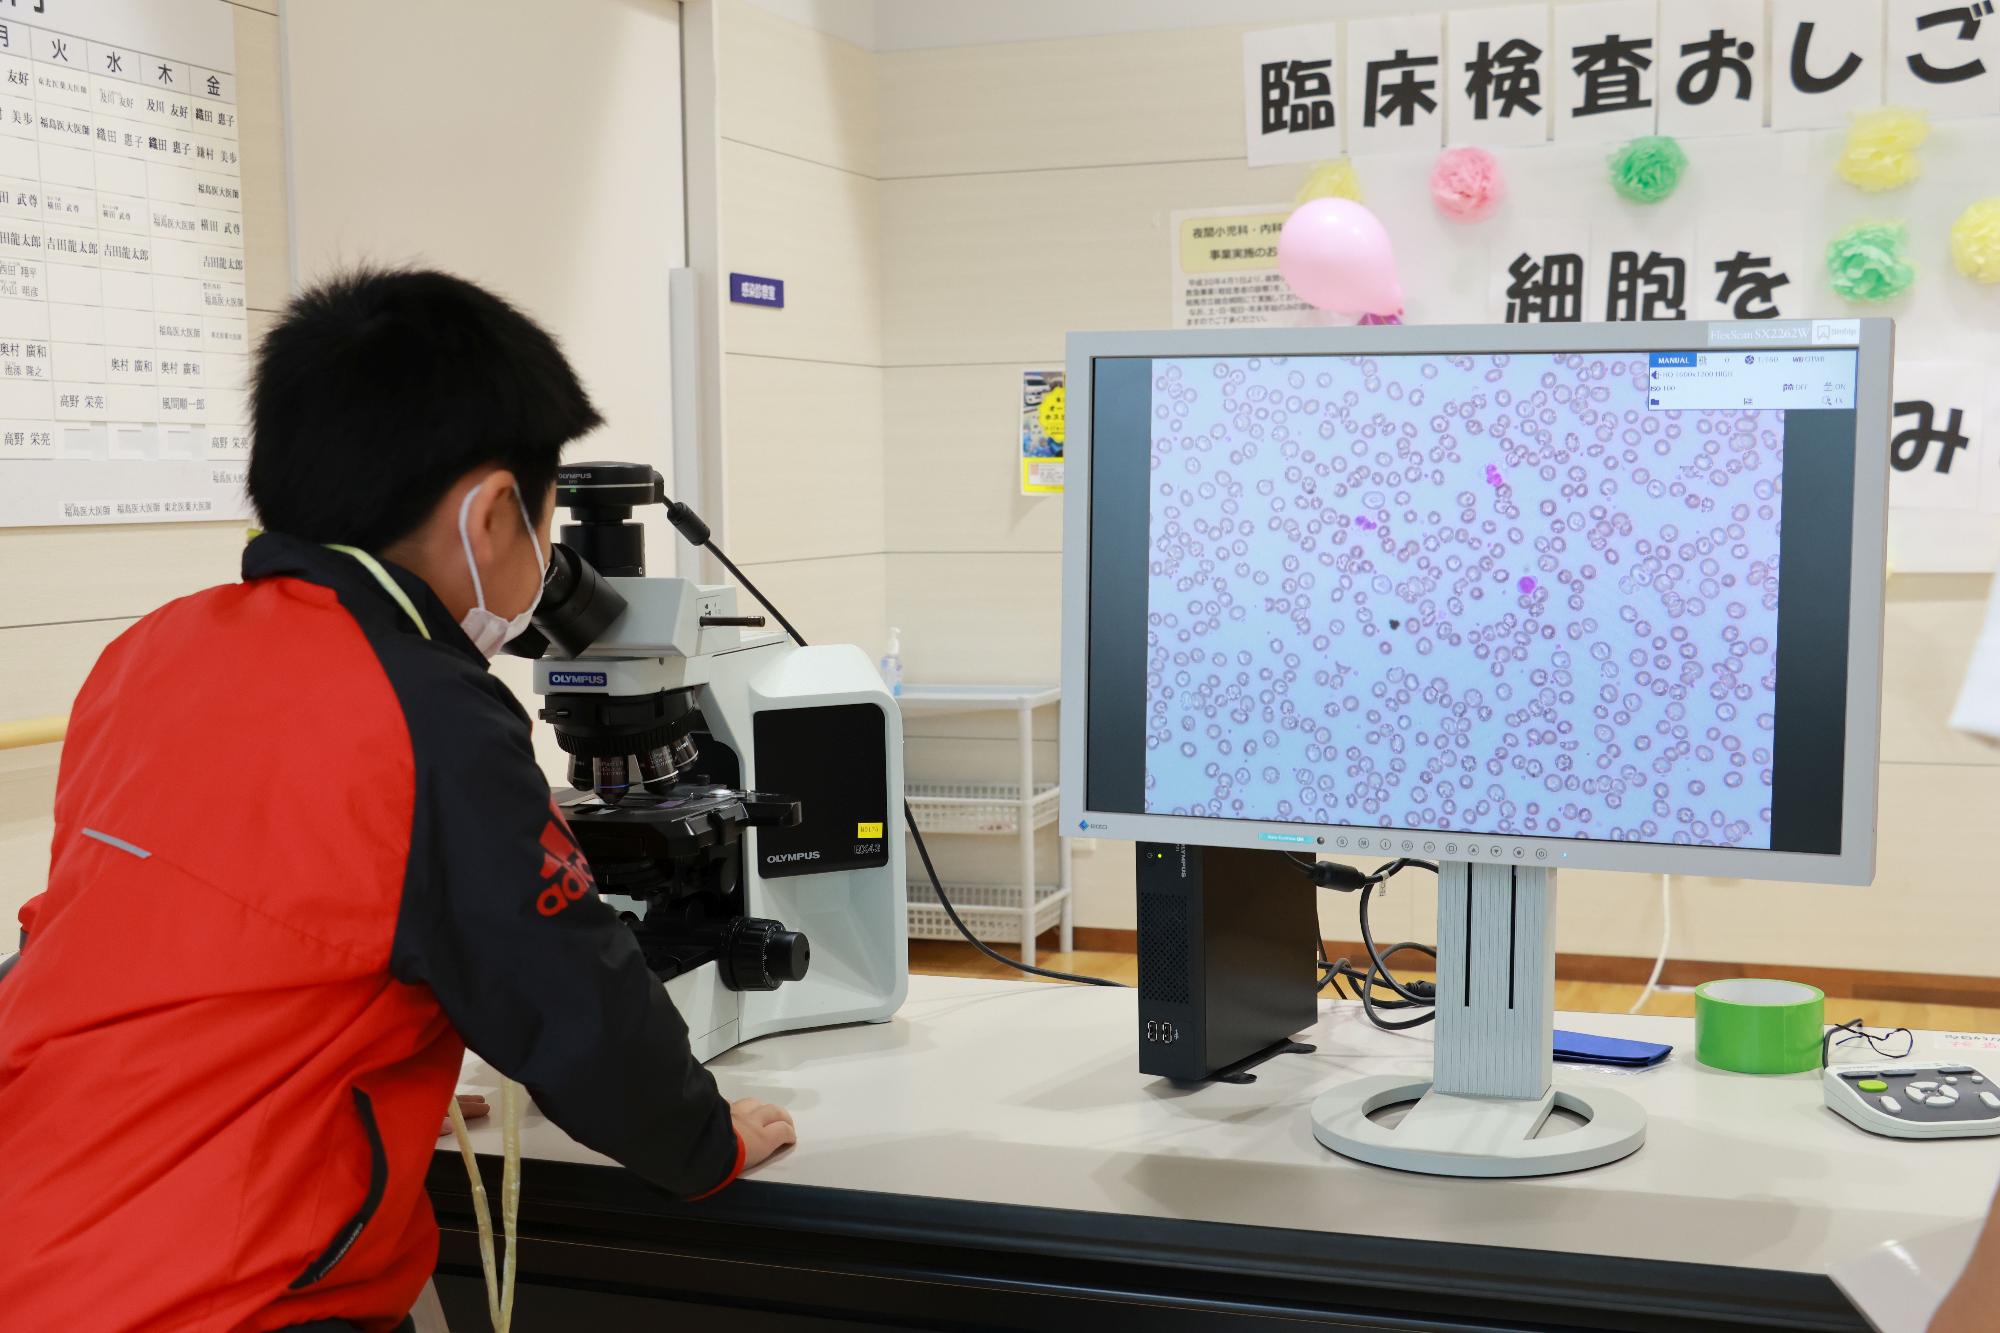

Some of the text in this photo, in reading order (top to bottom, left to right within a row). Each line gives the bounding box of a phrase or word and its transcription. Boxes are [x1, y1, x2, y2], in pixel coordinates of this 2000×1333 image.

[52, 39, 68, 62] 火
[107, 52, 122, 73] 水
[158, 64, 173, 85] 木
[207, 75, 221, 96] 金
[1505, 251, 1790, 322] 細胞を
[1658, 356, 1690, 364] MANUAL
[1890, 400, 1970, 474] み
[552, 674, 605, 685] OLYMPUS
[766, 851, 820, 863] OLYMPUS
